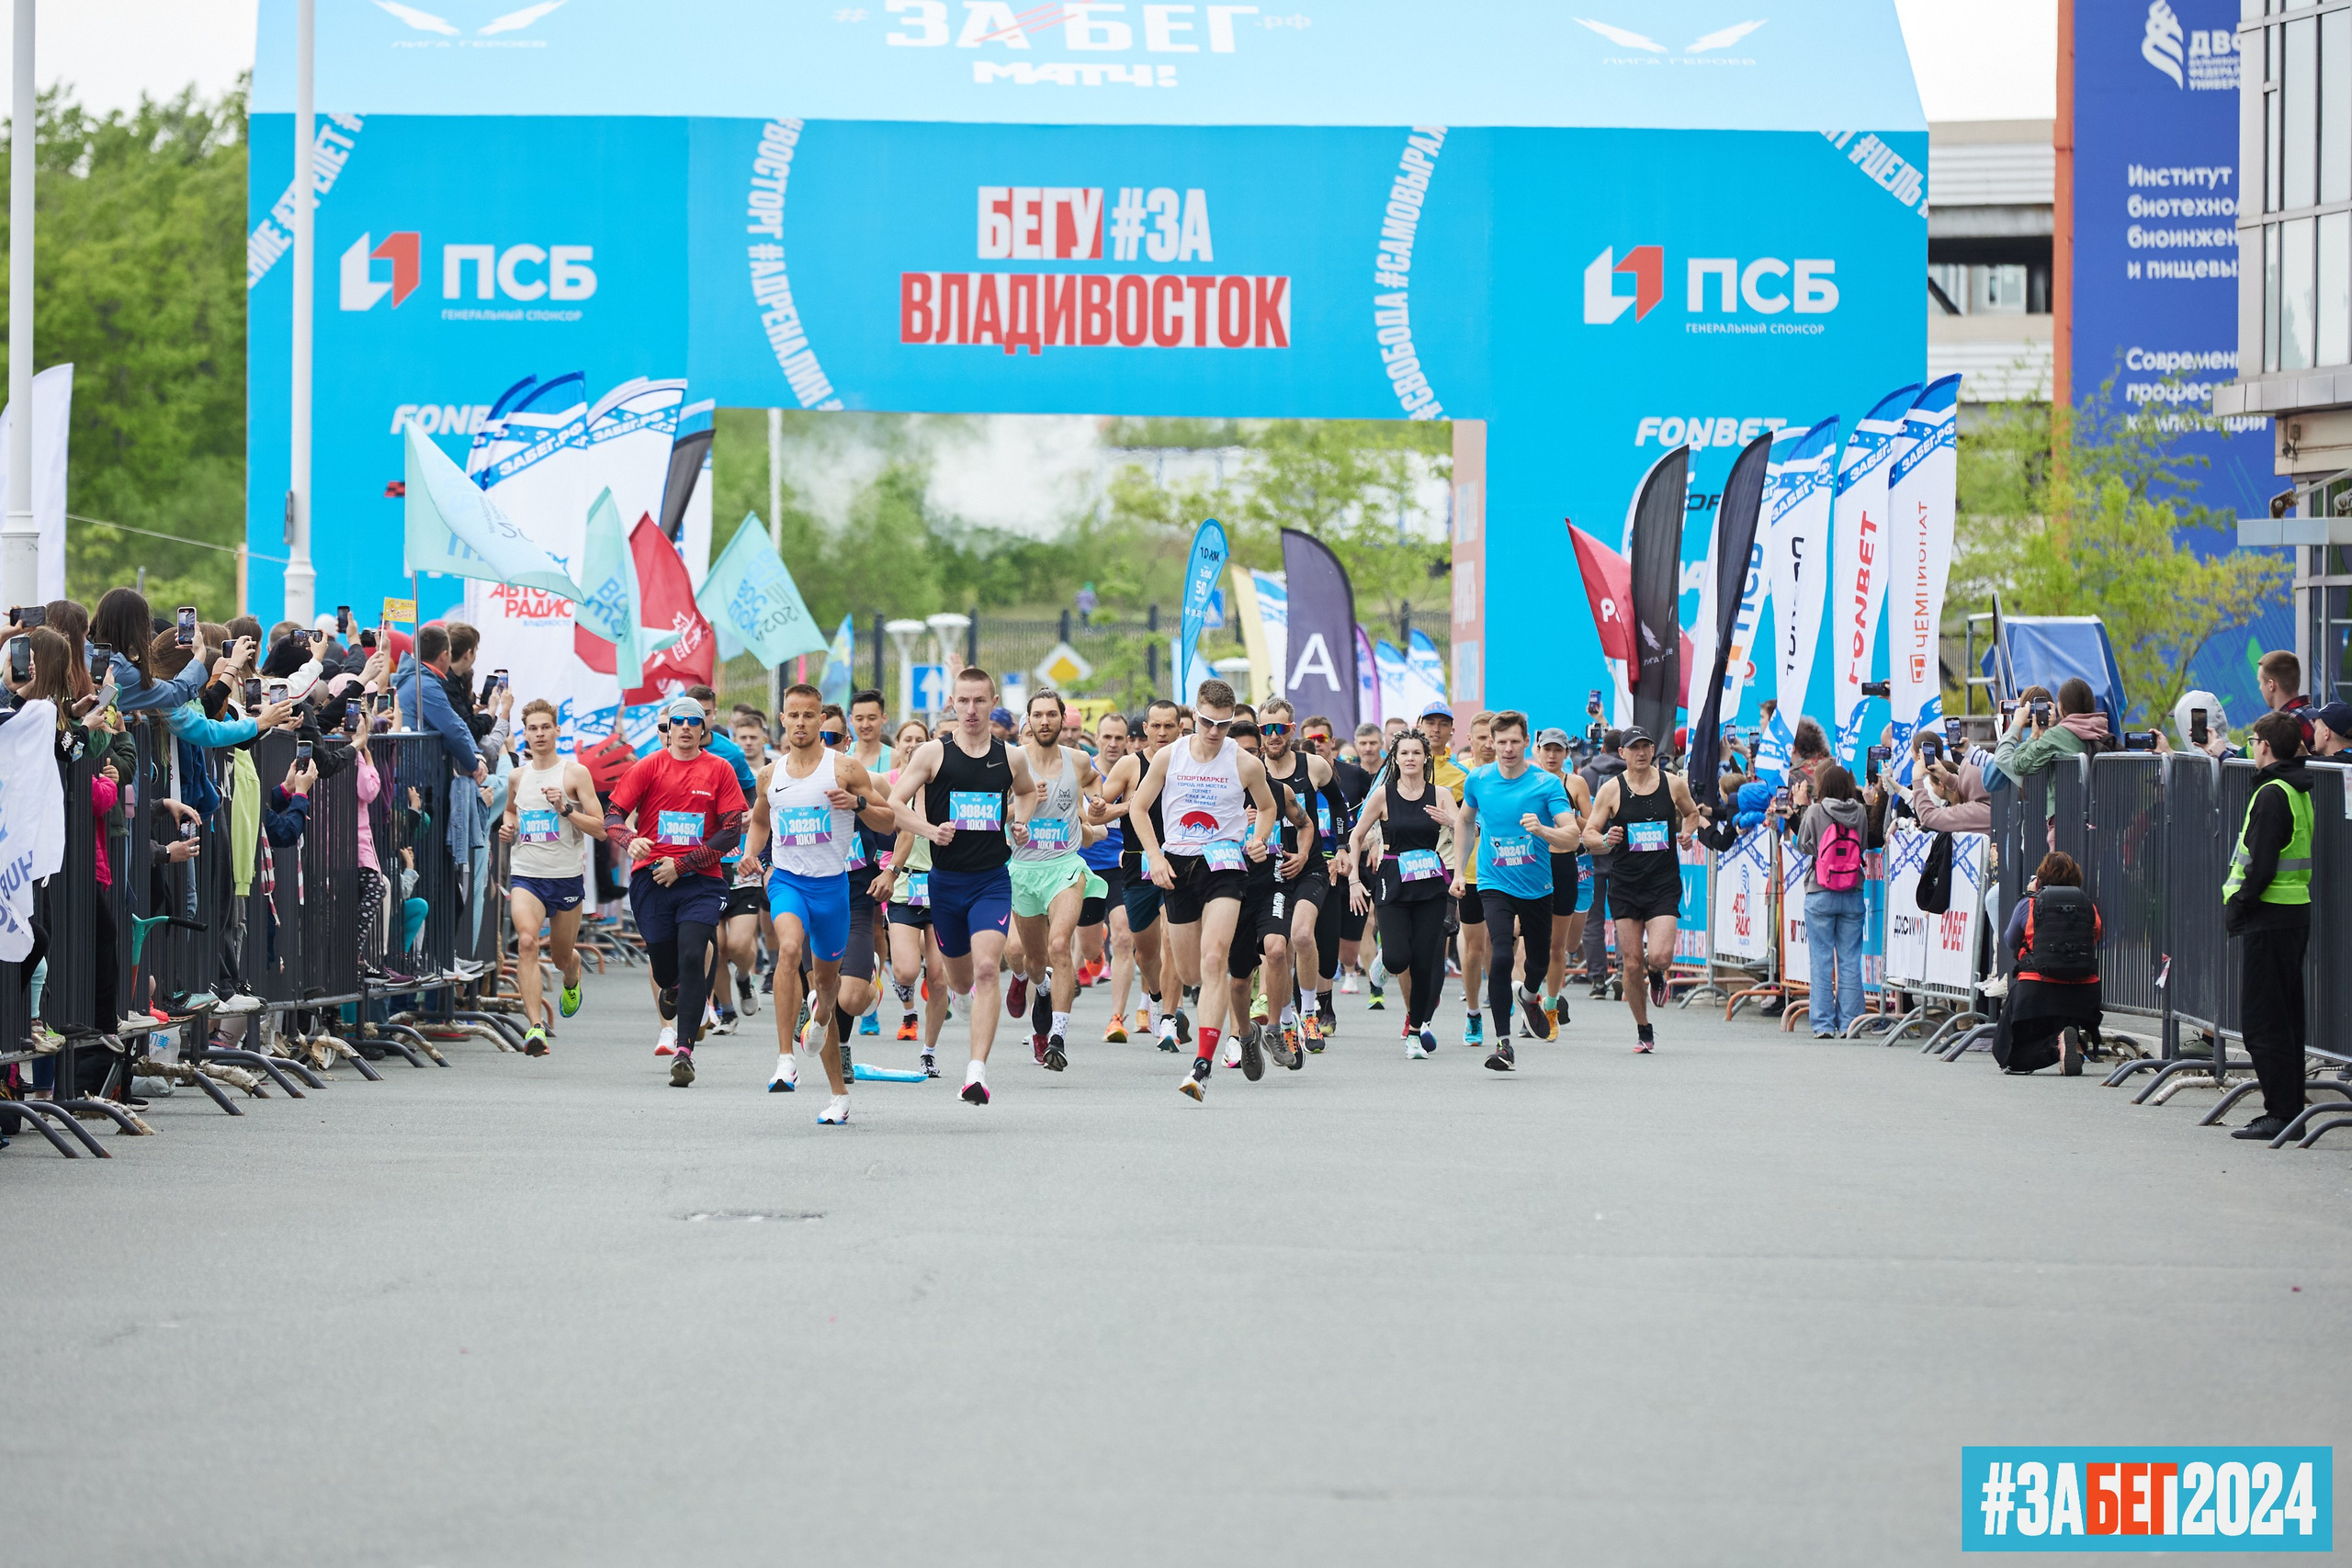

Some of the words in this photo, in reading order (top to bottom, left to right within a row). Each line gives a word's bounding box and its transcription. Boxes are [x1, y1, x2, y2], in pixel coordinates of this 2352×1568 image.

[390, 39, 453, 49] ЛИГА
[458, 39, 548, 49] ГЕРОЕВ
[973, 61, 1179, 87] МАТЧ!
[2127, 164, 2233, 191] Институт
[978, 186, 1103, 260] БЕГУ
[1110, 186, 1214, 263] #ЗА
[443, 243, 597, 301] ПСБ
[2127, 260, 2142, 279] и
[2146, 259, 2240, 281] пищевы
[1687, 257, 1840, 315] ПСБ
[441, 309, 525, 321] ГЕНЕРАЛЬНЫЙ
[526, 310, 583, 321] СПОНСОР
[746, 243, 835, 409] #АДРЕНАЛИН
[900, 272, 1291, 355] ВЛАДИВОСТОК
[1685, 321, 1767, 334] ГЕНЕРАЛЬНЫЙ
[1769, 323, 1826, 335] СПОНСОР
[592, 411, 665, 442] ЗАБЕГ.РФ
[499, 422, 585, 476] ЗАБЕГ.РФ
[1287, 632, 1341, 692] A
[959, 804, 993, 818] 30842
[666, 822, 696, 835] 30452
[789, 818, 821, 834] 30281
[1034, 828, 1060, 840] 30671
